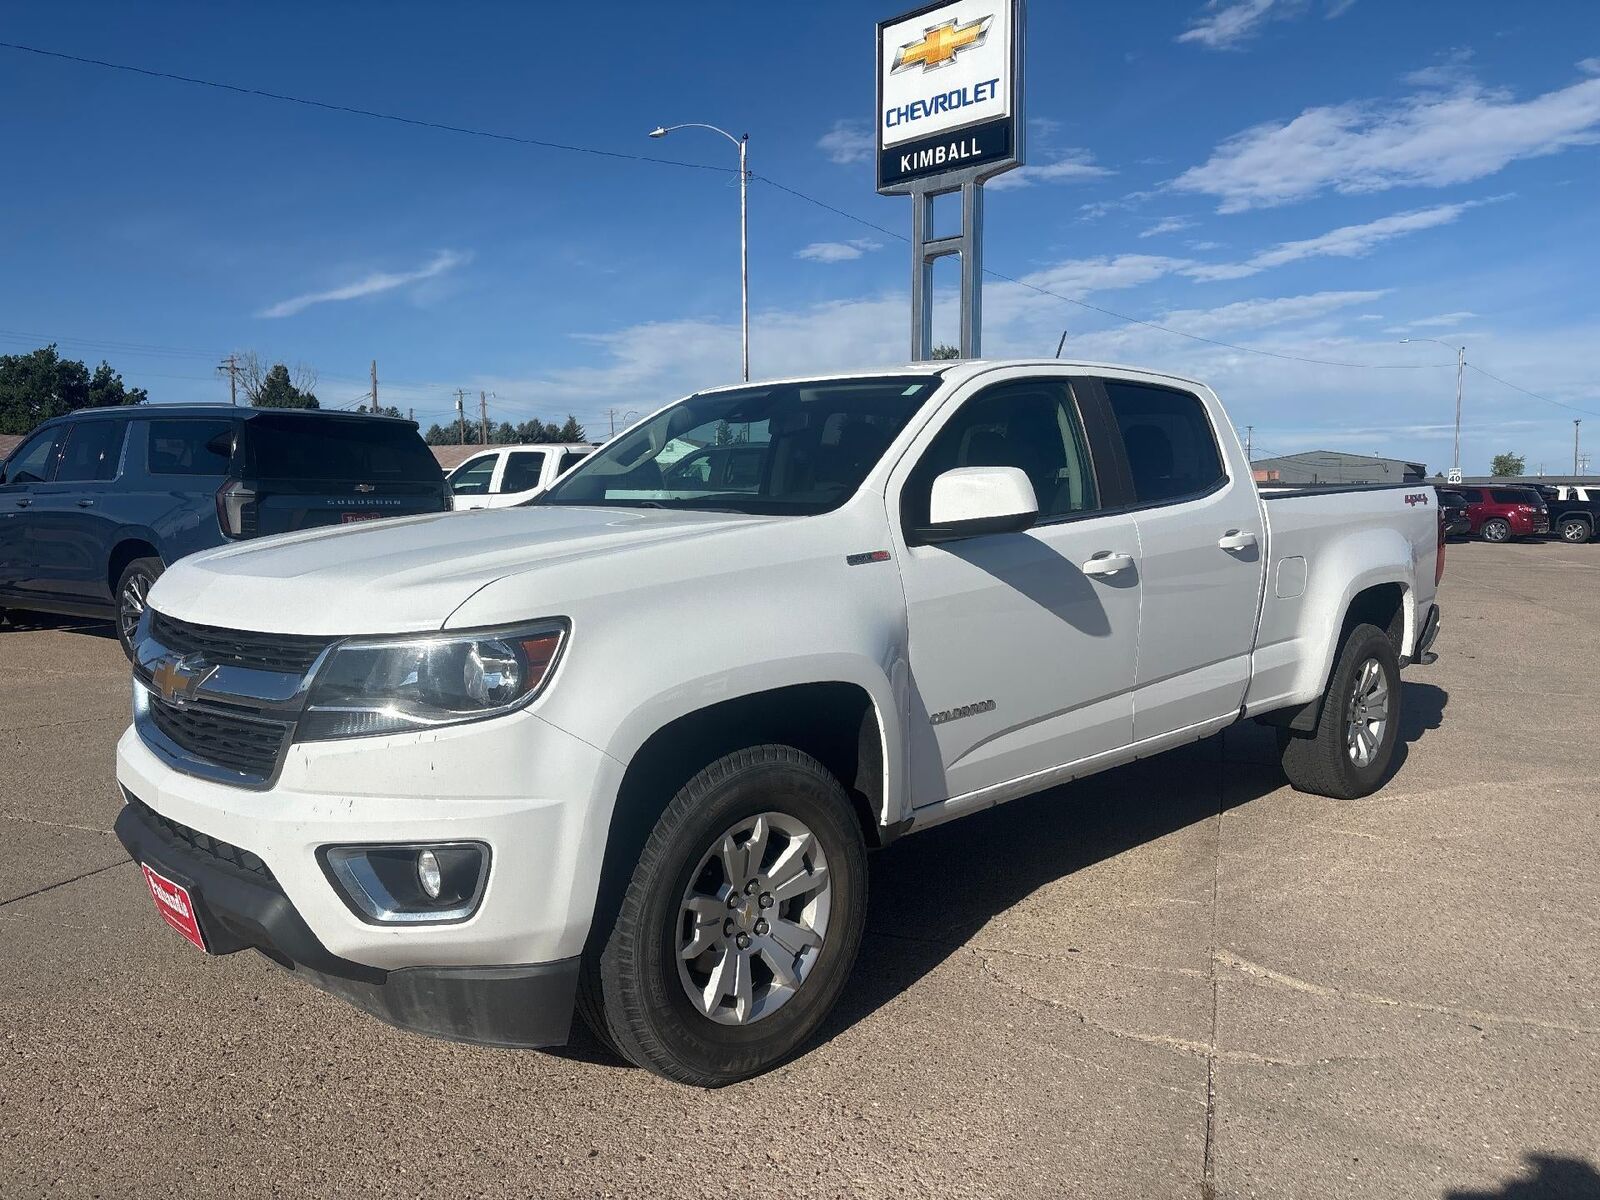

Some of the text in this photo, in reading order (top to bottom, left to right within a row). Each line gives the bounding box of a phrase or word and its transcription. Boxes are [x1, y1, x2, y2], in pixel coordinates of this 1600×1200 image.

[885, 78, 1000, 128] CHEVROLET
[900, 137, 982, 172] KIMBALL
[929, 699, 997, 725] COLORADO
